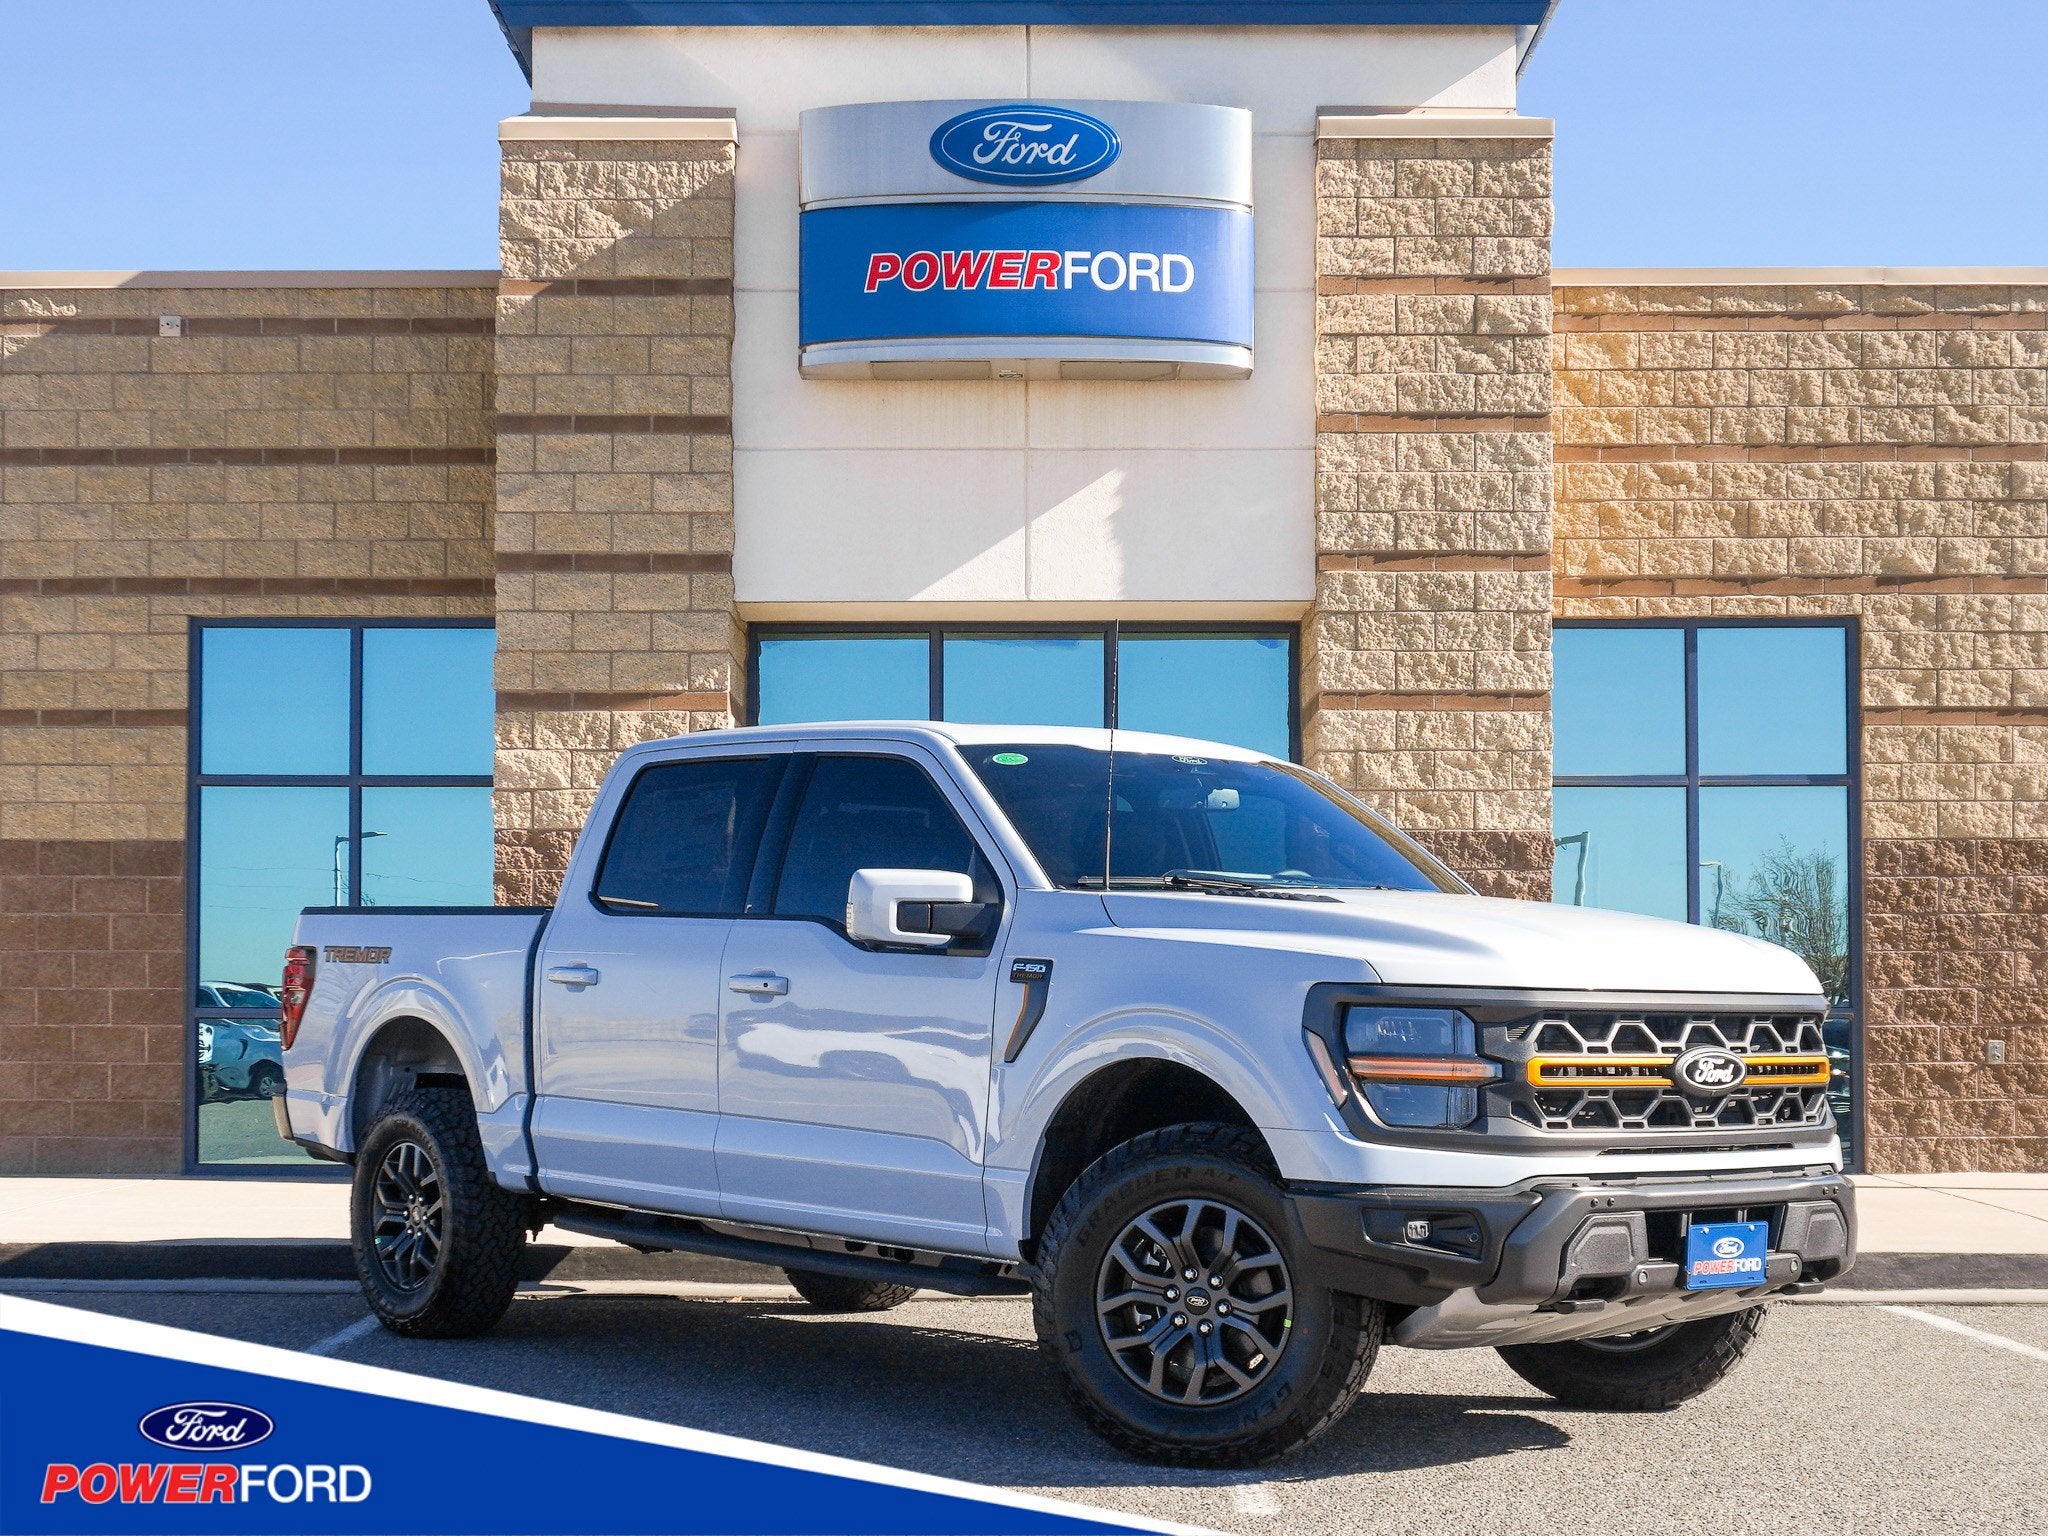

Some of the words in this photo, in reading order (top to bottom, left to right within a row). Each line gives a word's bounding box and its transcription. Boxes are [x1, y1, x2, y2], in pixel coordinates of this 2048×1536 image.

[973, 121, 1079, 166] Ford
[323, 945, 392, 963] TREMOR
[1012, 963, 1046, 973] F-150
[1694, 1057, 1735, 1083] Ford
